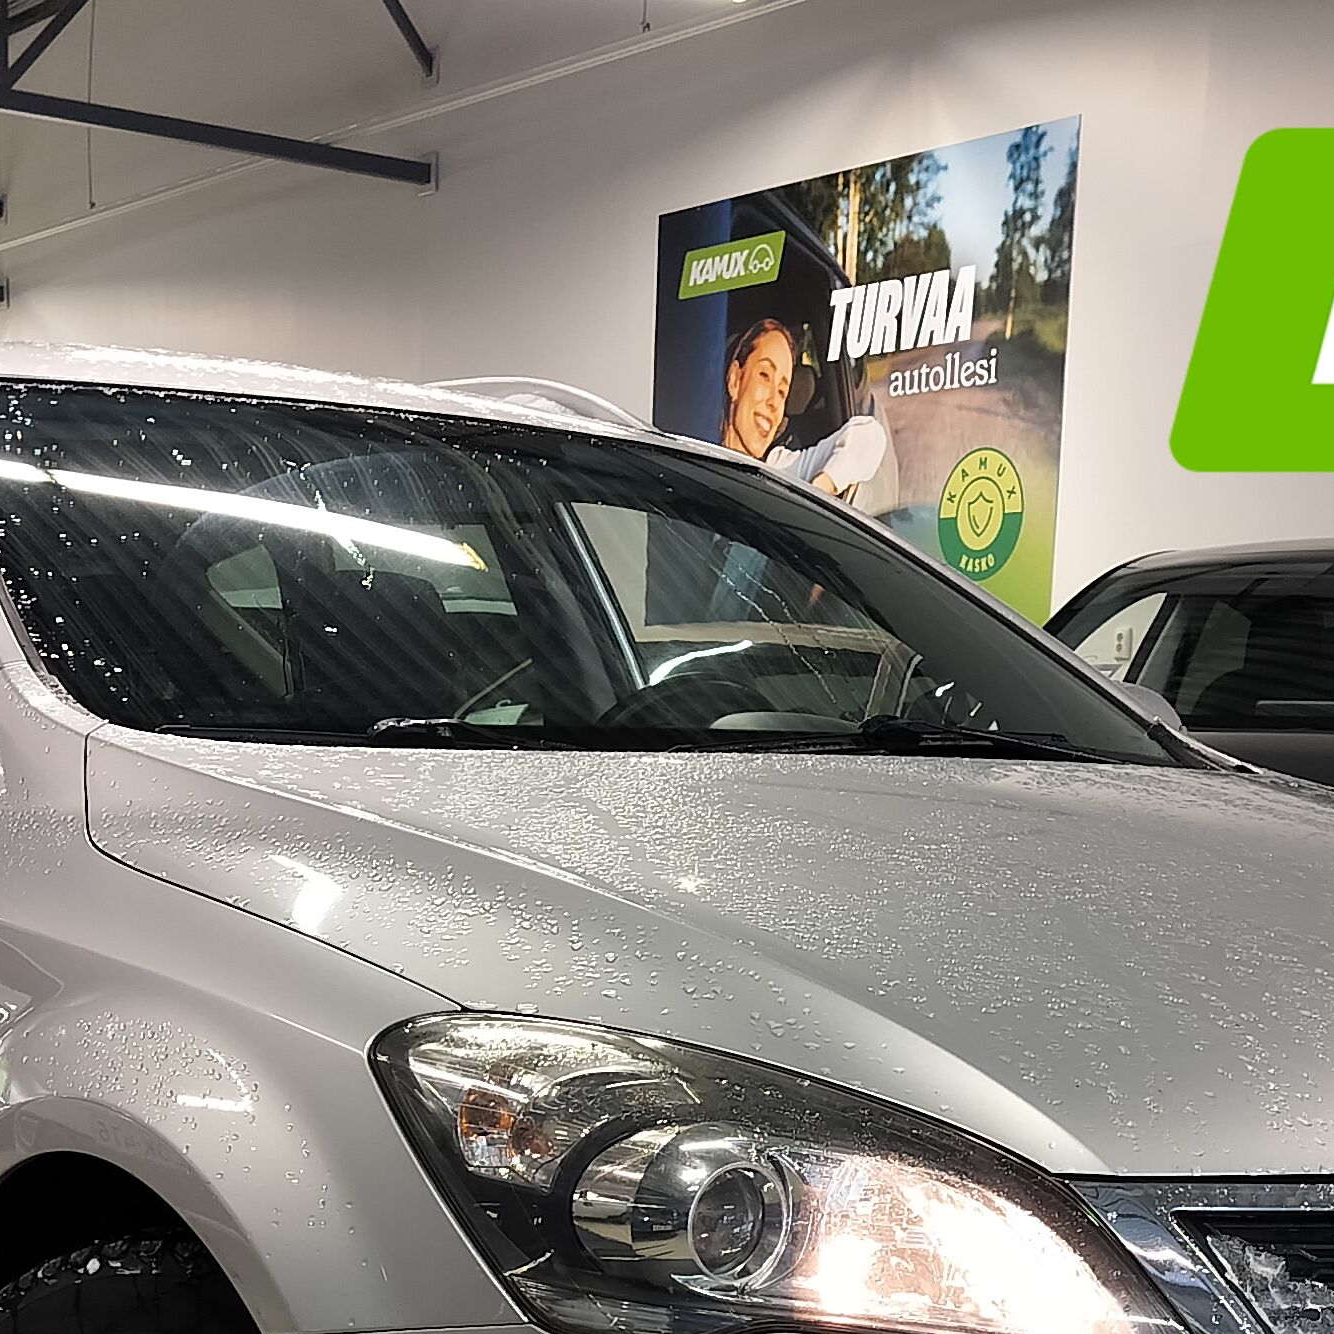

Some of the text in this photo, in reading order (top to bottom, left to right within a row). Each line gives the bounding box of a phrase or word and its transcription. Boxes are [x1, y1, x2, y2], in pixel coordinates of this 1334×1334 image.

[688, 251, 748, 286] KAMUX
[827, 265, 976, 361] TURVAA
[889, 349, 998, 397] autollesi
[947, 457, 1017, 503] KAMUX
[959, 553, 995, 573] KASKO
